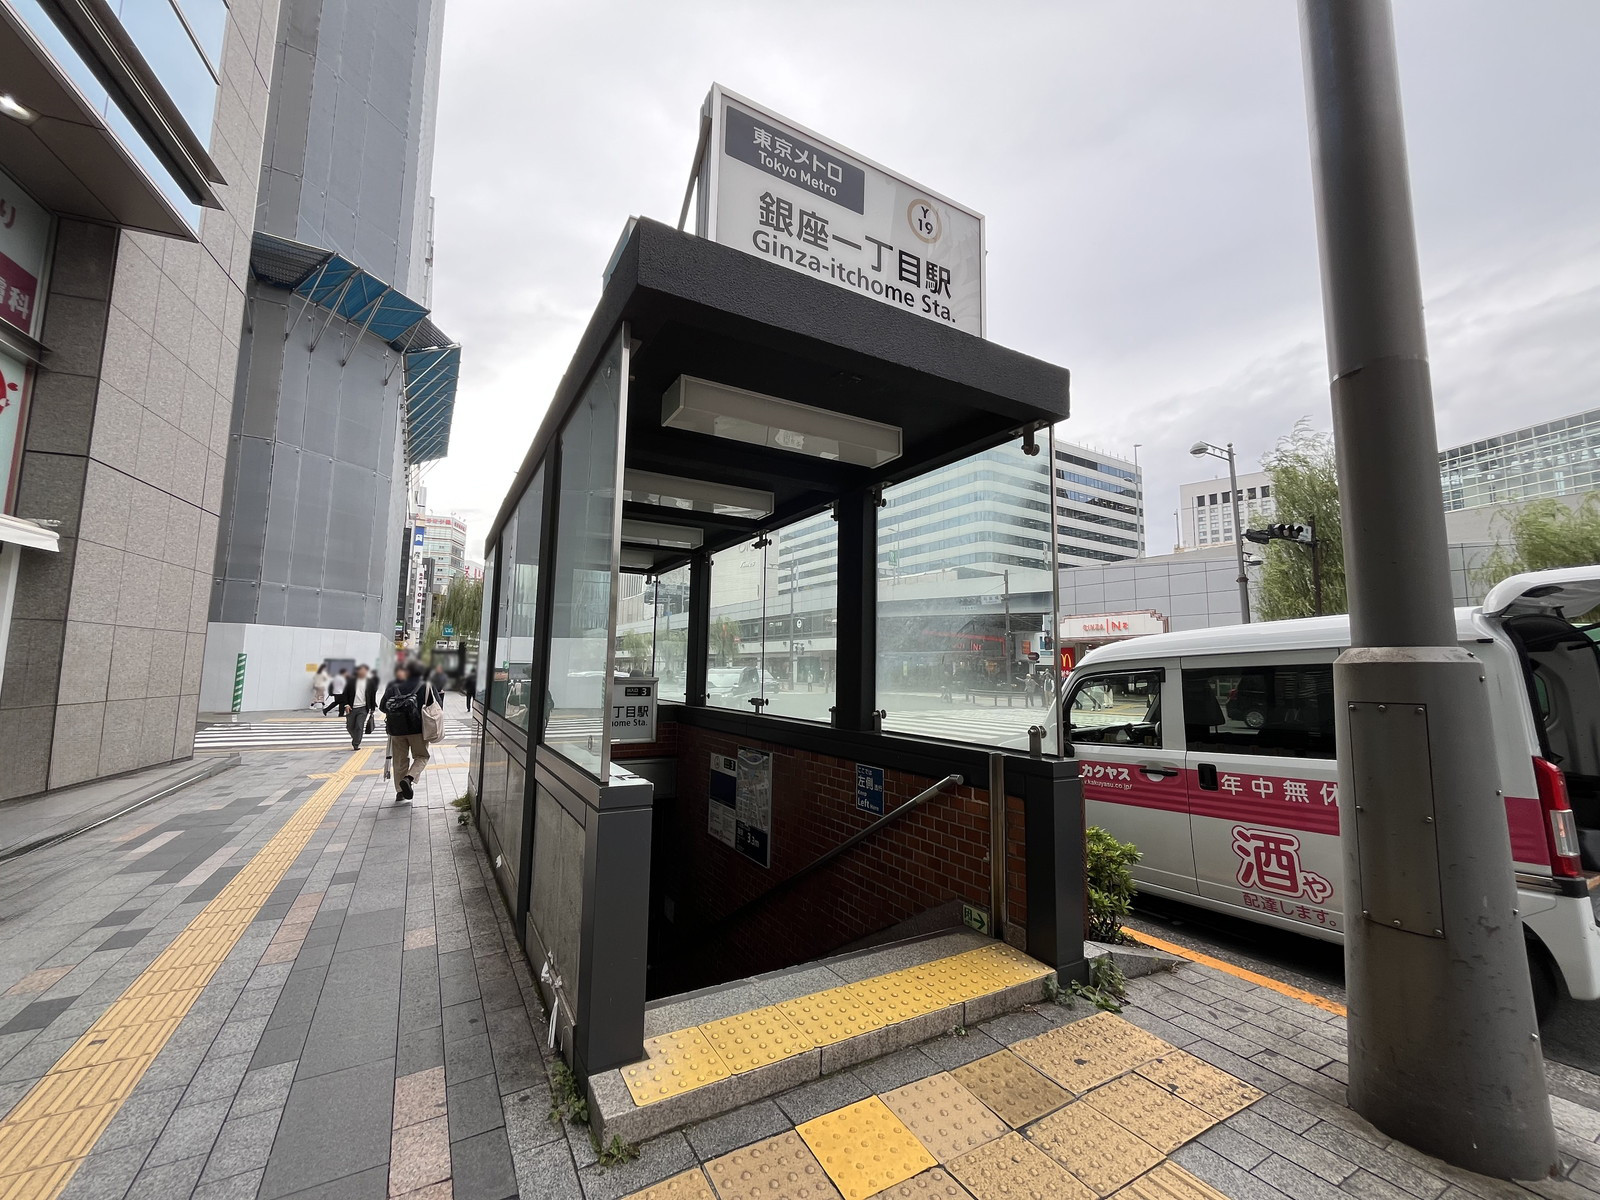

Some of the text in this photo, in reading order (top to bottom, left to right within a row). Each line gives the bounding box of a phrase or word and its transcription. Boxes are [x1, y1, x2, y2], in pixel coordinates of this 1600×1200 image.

[753, 126, 843, 184] 東京メトロ
[759, 150, 837, 197] Tokyo Metro
[921, 206, 930, 219] Y
[918, 219, 934, 235] 19
[759, 191, 952, 300] 銀座一丁目駅
[752, 229, 956, 323] Ginza-itchome Sta.
[641, 687, 647, 696] 3
[613, 705, 649, 719] 丁目駅
[633, 718, 648, 726] Sta.
[730, 760, 735, 770] 3
[1082, 764, 1131, 782] カクヤス
[1221, 775, 1340, 807] 年中無休
[858, 797, 870, 808] Left
[1232, 825, 1333, 904] 酒や
[1242, 892, 1337, 927] 配達します。
